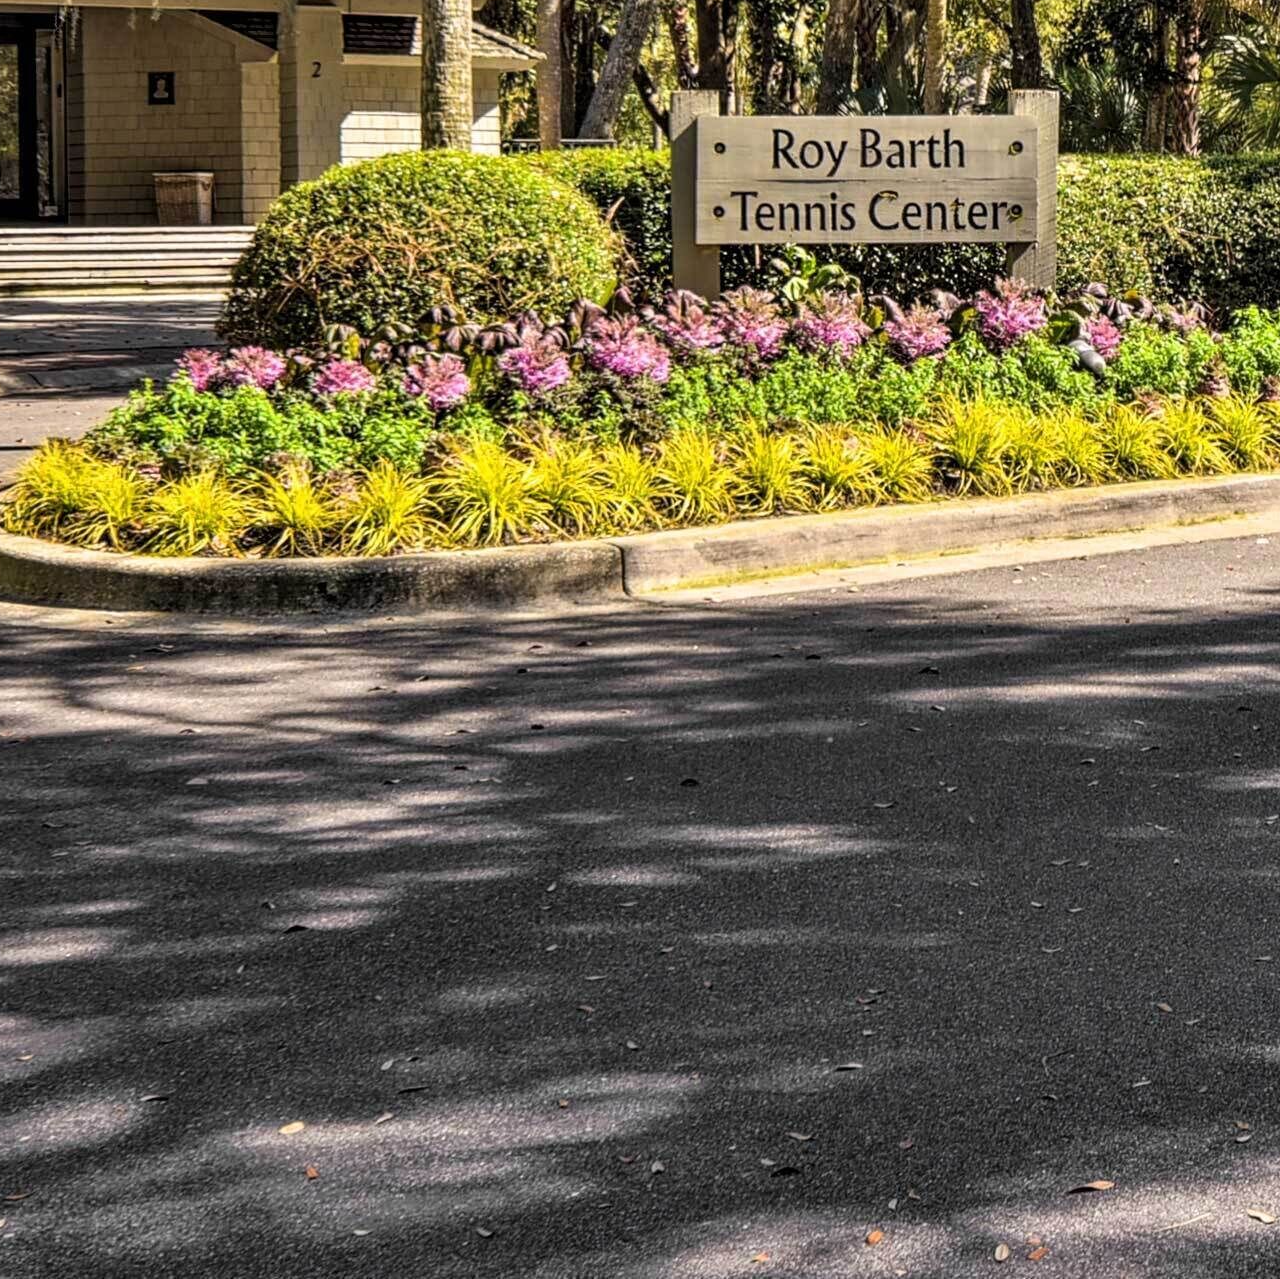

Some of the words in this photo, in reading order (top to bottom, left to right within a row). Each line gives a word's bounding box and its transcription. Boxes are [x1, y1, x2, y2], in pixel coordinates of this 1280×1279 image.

[311, 60, 322, 78] 2
[772, 128, 848, 177] Roy
[860, 128, 965, 169] Barth
[730, 191, 856, 231] Tennis
[869, 190, 1008, 231] Center
